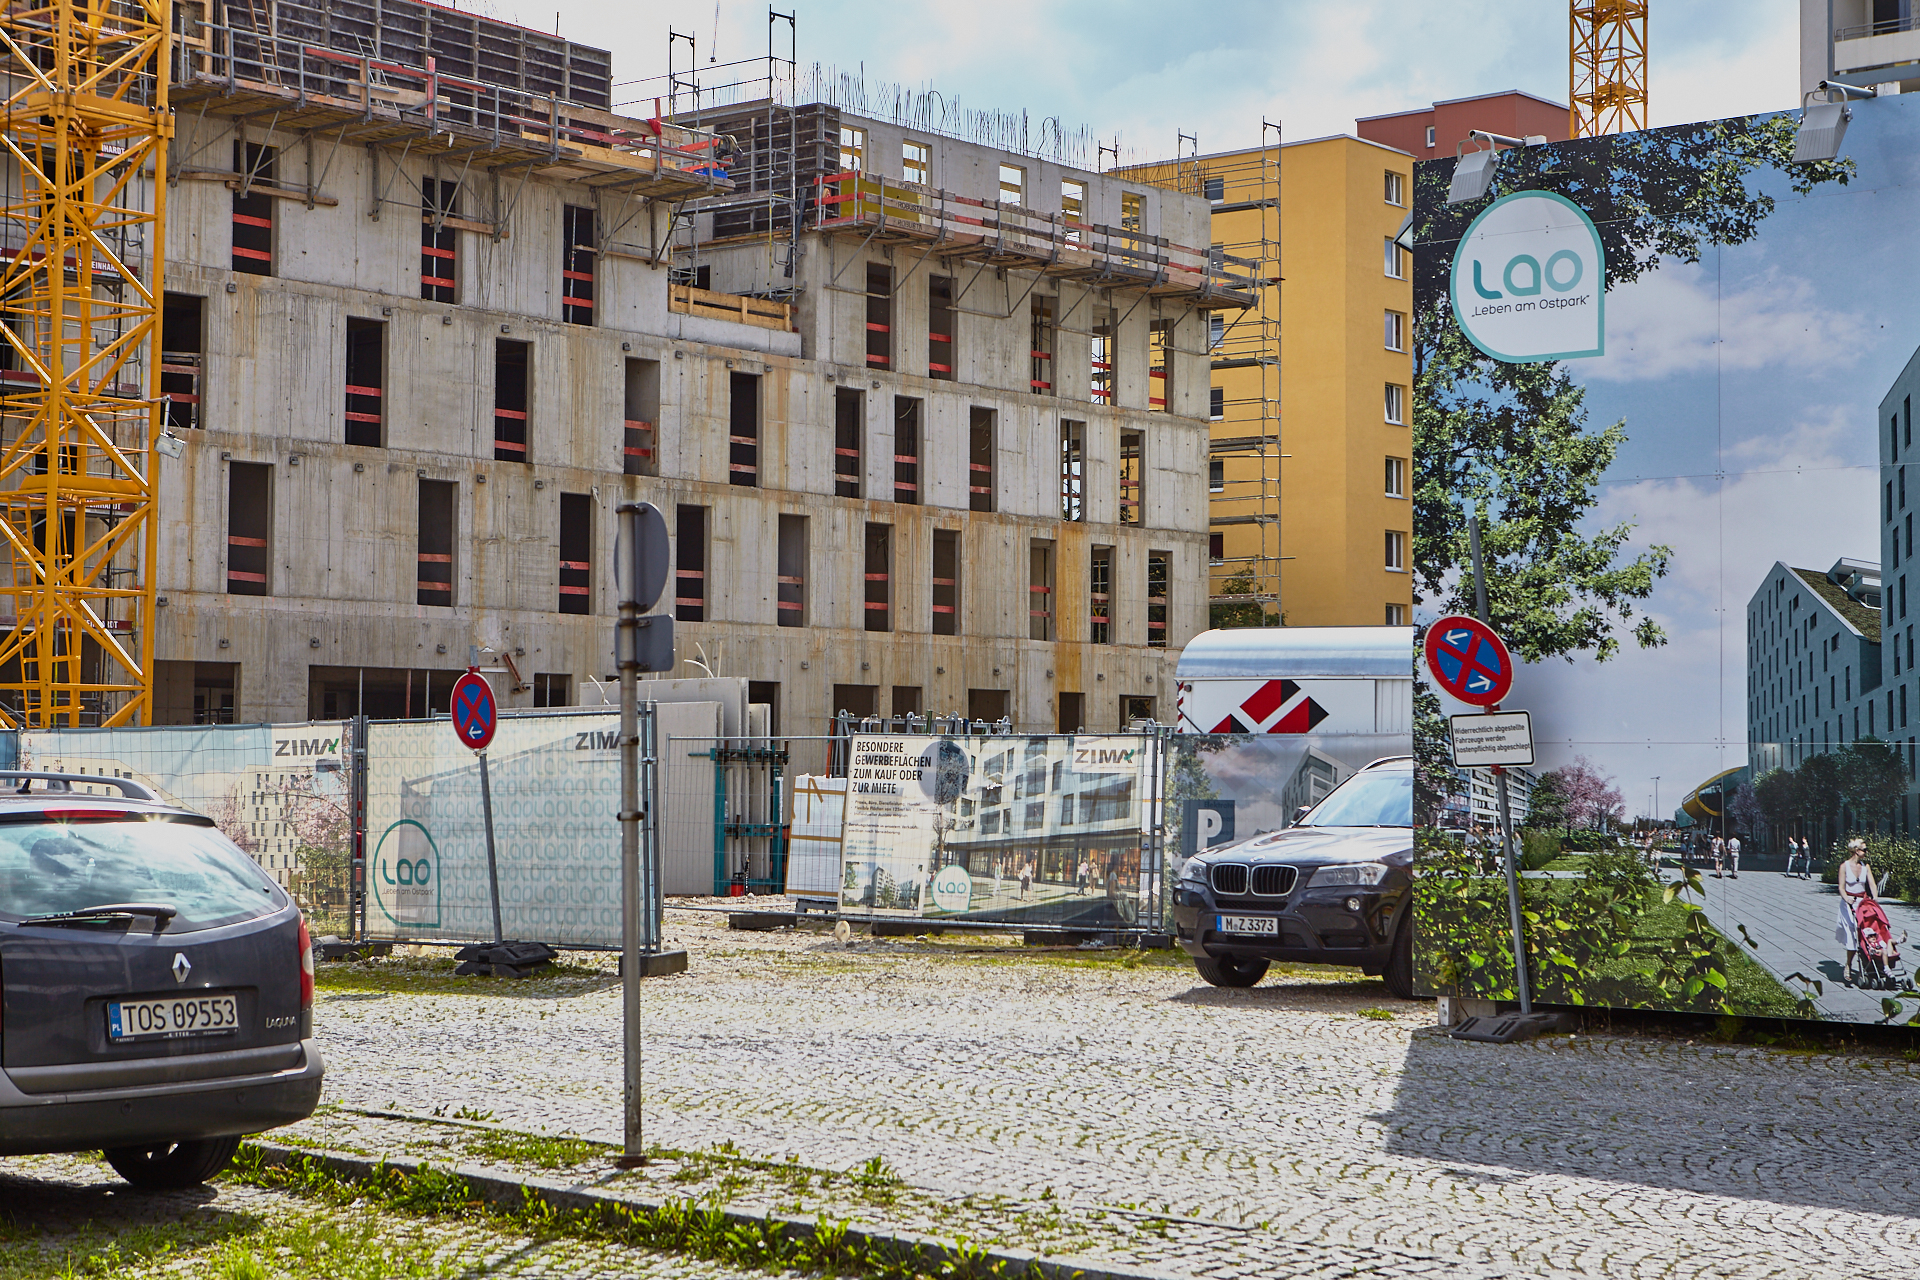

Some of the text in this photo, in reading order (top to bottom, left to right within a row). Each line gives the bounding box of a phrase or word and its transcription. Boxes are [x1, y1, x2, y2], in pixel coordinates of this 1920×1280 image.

[897, 201, 924, 214] ROBUSTA
[897, 219, 923, 231] ROBUSTA
[1515, 302, 1536, 312] am
[1453, 724, 1525, 734] Widerrechtlich abgestellte
[275, 738, 340, 757] ZIMA
[856, 741, 904, 752] BESONDERE
[1456, 745, 1496, 753] kostenpflichtig
[855, 753, 932, 767] GEWERBEFLÄCHEN
[1074, 748, 1135, 764] ZIMA
[853, 768, 923, 781] ZUM KAUF ODER
[852, 782, 897, 794] ZUR MIETE
[1196, 809, 1223, 852] P
[1225, 917, 1274, 932] M Z 3373
[123, 999, 236, 1033] TOS 09553
